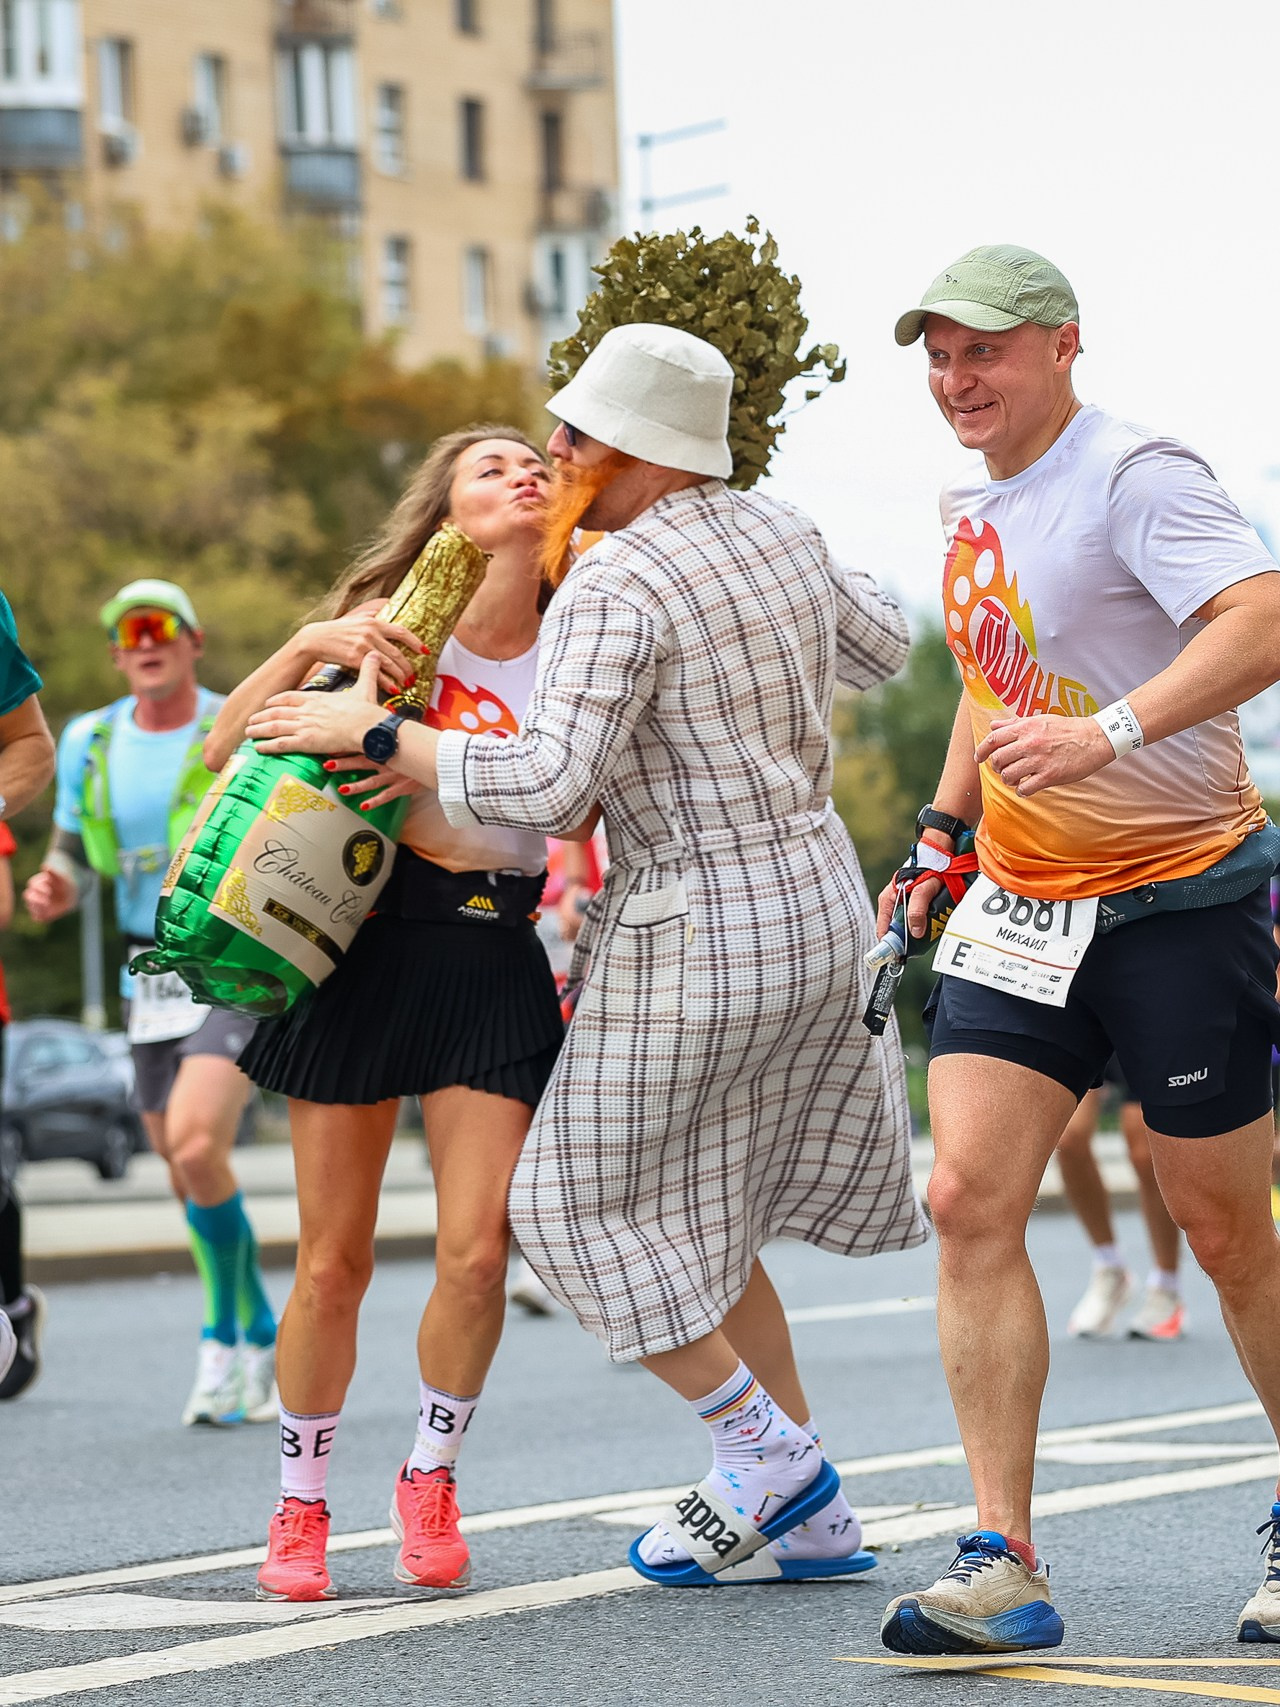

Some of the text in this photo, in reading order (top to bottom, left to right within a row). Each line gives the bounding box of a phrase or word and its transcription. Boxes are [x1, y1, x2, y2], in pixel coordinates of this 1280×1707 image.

[253, 839, 332, 906] Château
[995, 926, 1048, 952] МИХАИЛ
[950, 941, 972, 968] E
[1167, 1067, 1208, 1088] SONU
[674, 1489, 742, 1560] appa
